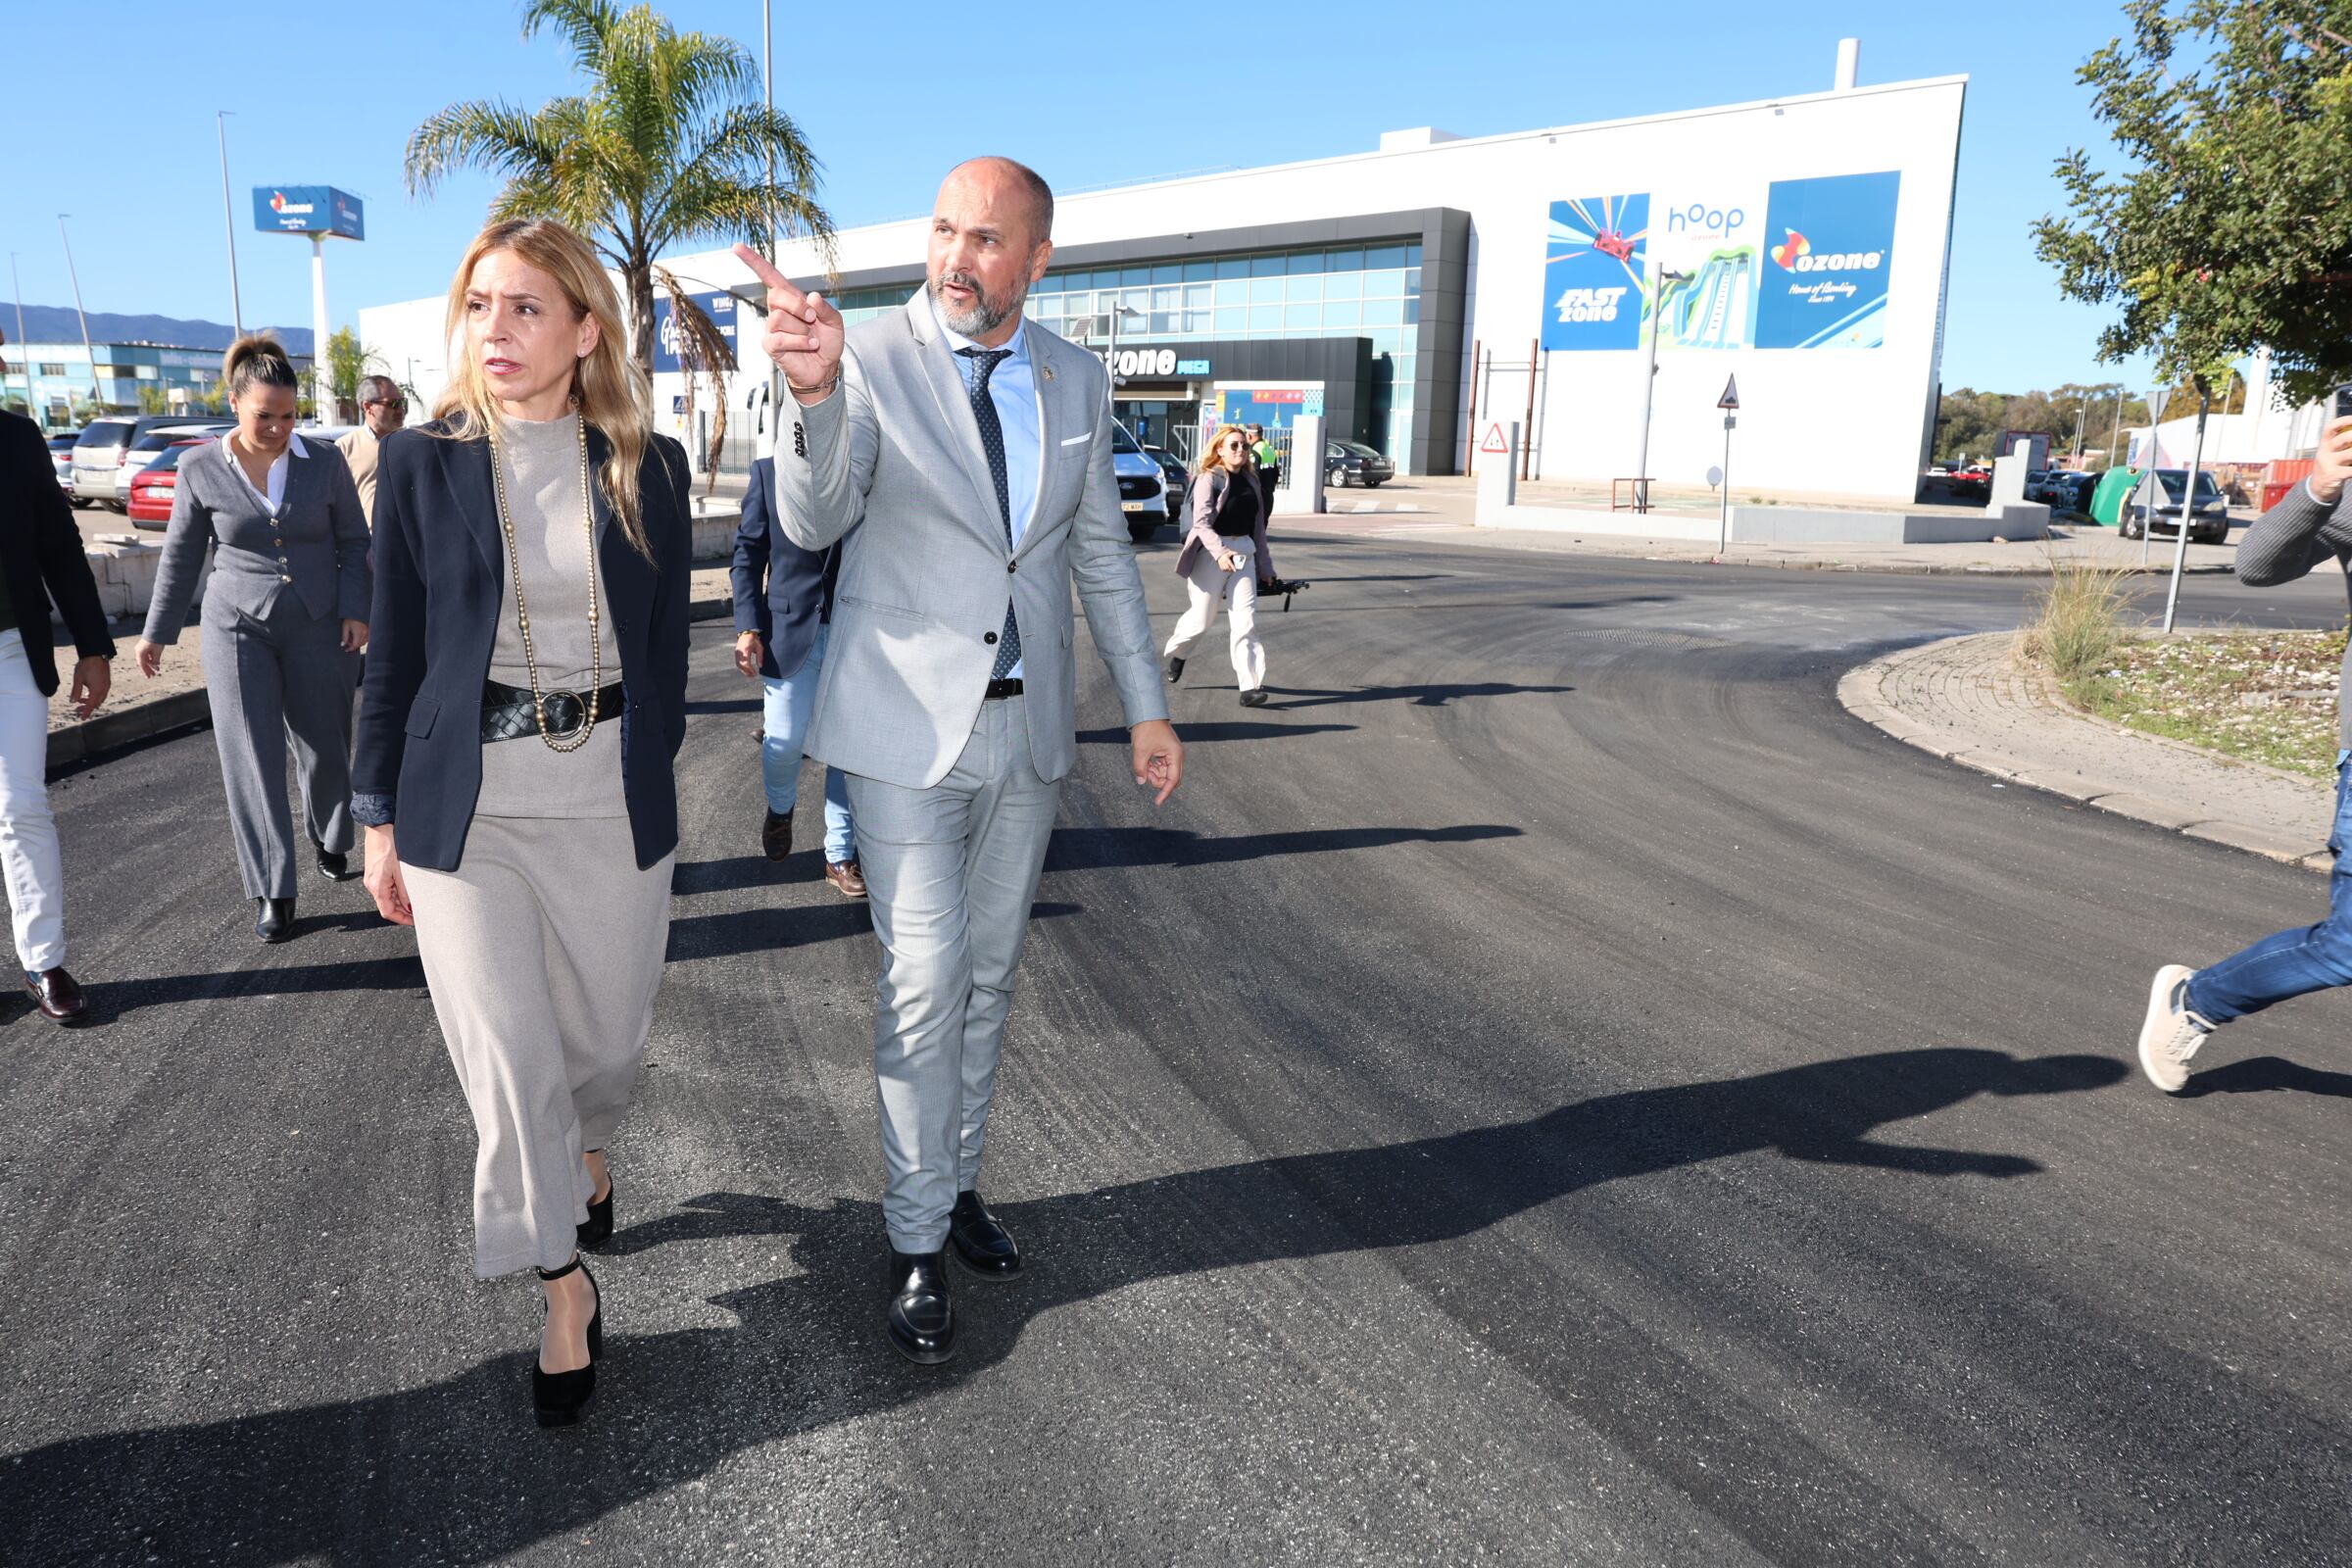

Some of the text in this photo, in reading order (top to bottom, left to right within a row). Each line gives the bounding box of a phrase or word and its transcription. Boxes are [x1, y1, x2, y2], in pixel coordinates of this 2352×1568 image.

[1668, 203, 1744, 239] hoop
[1795, 252, 1882, 272] ozone
[1553, 286, 1628, 308] FAST
[1557, 306, 1618, 323] zone
